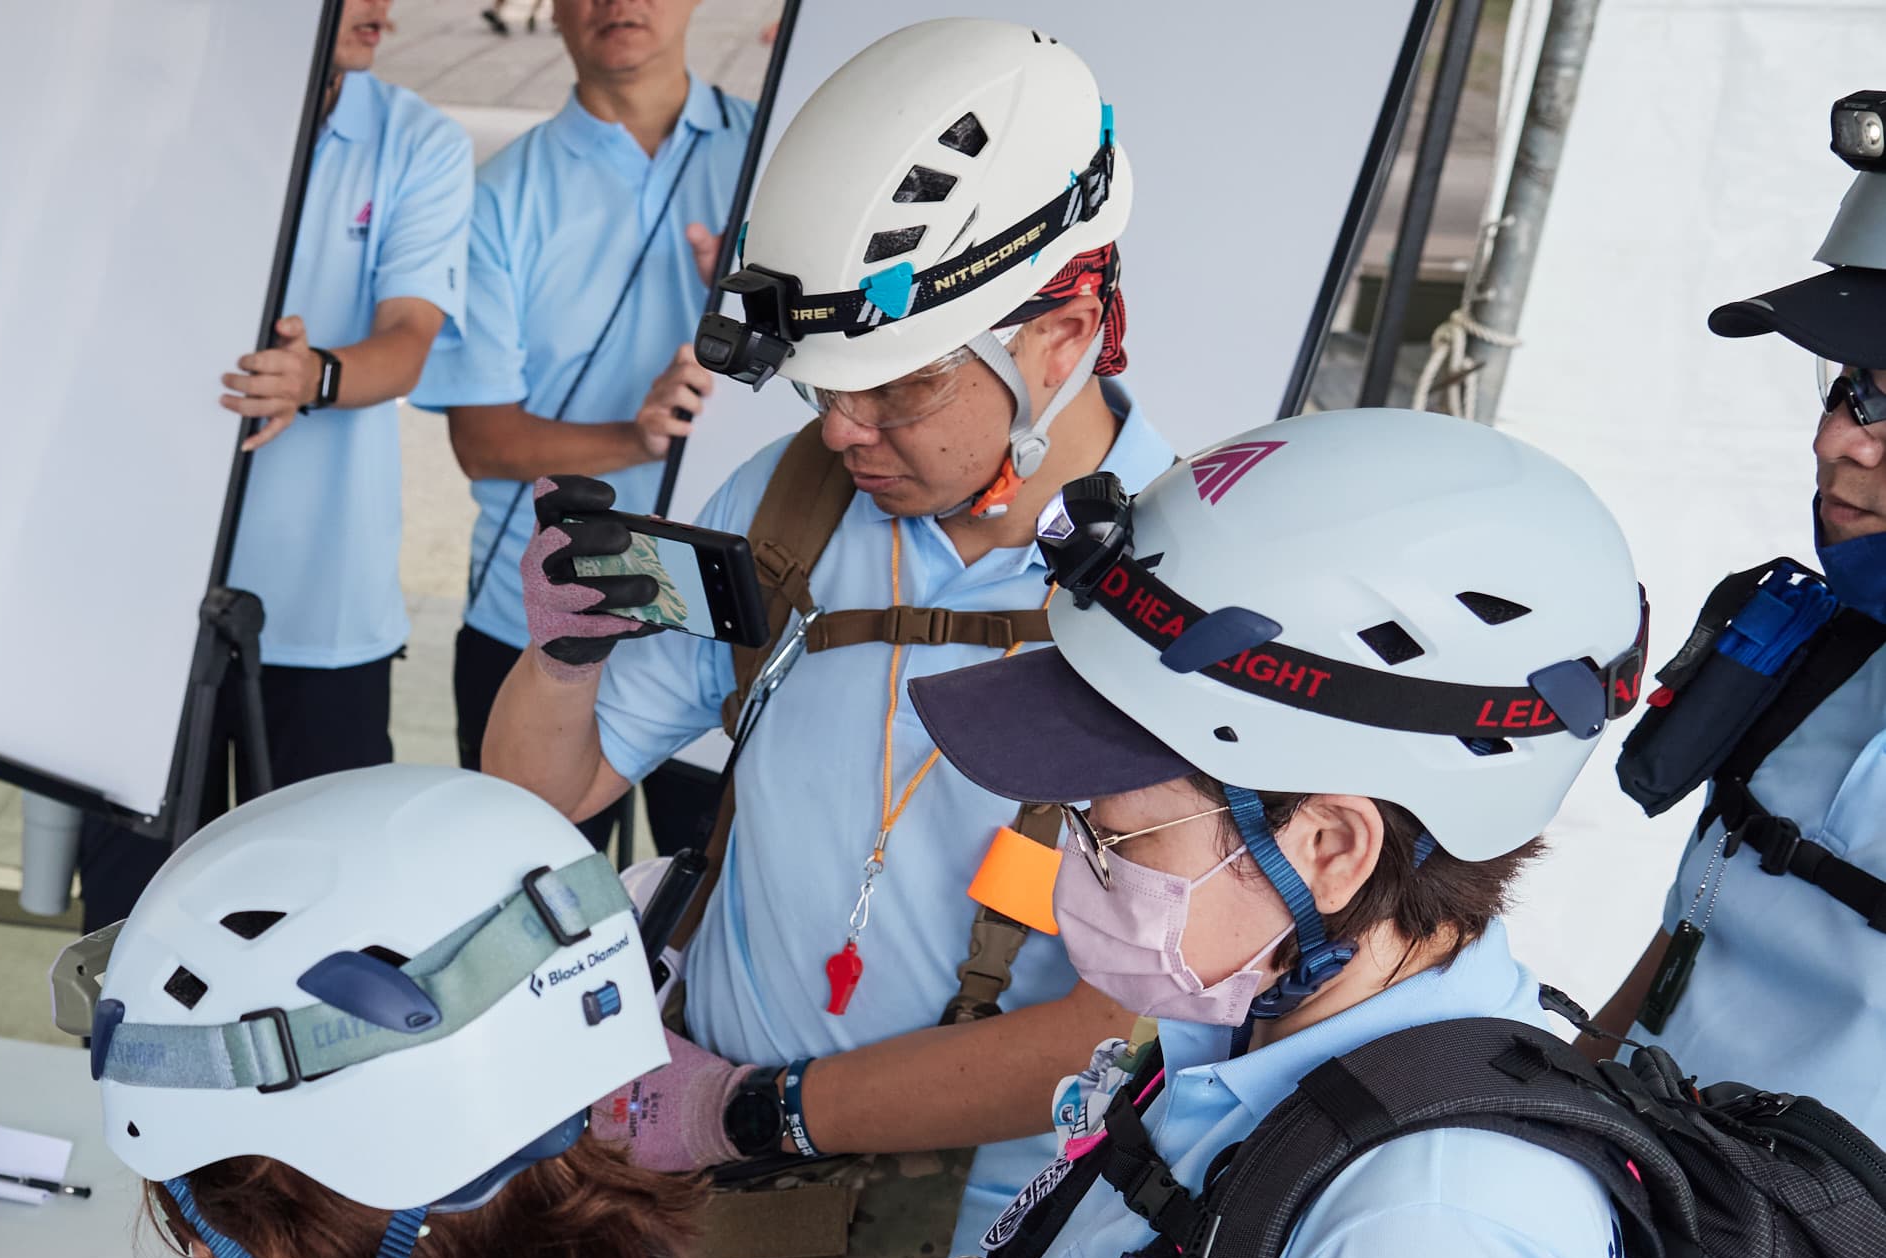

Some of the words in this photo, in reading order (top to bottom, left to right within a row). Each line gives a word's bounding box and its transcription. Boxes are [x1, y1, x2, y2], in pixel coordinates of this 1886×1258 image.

[932, 222, 1044, 293] NITECORE
[547, 959, 586, 986] Black
[586, 930, 630, 968] Diamond
